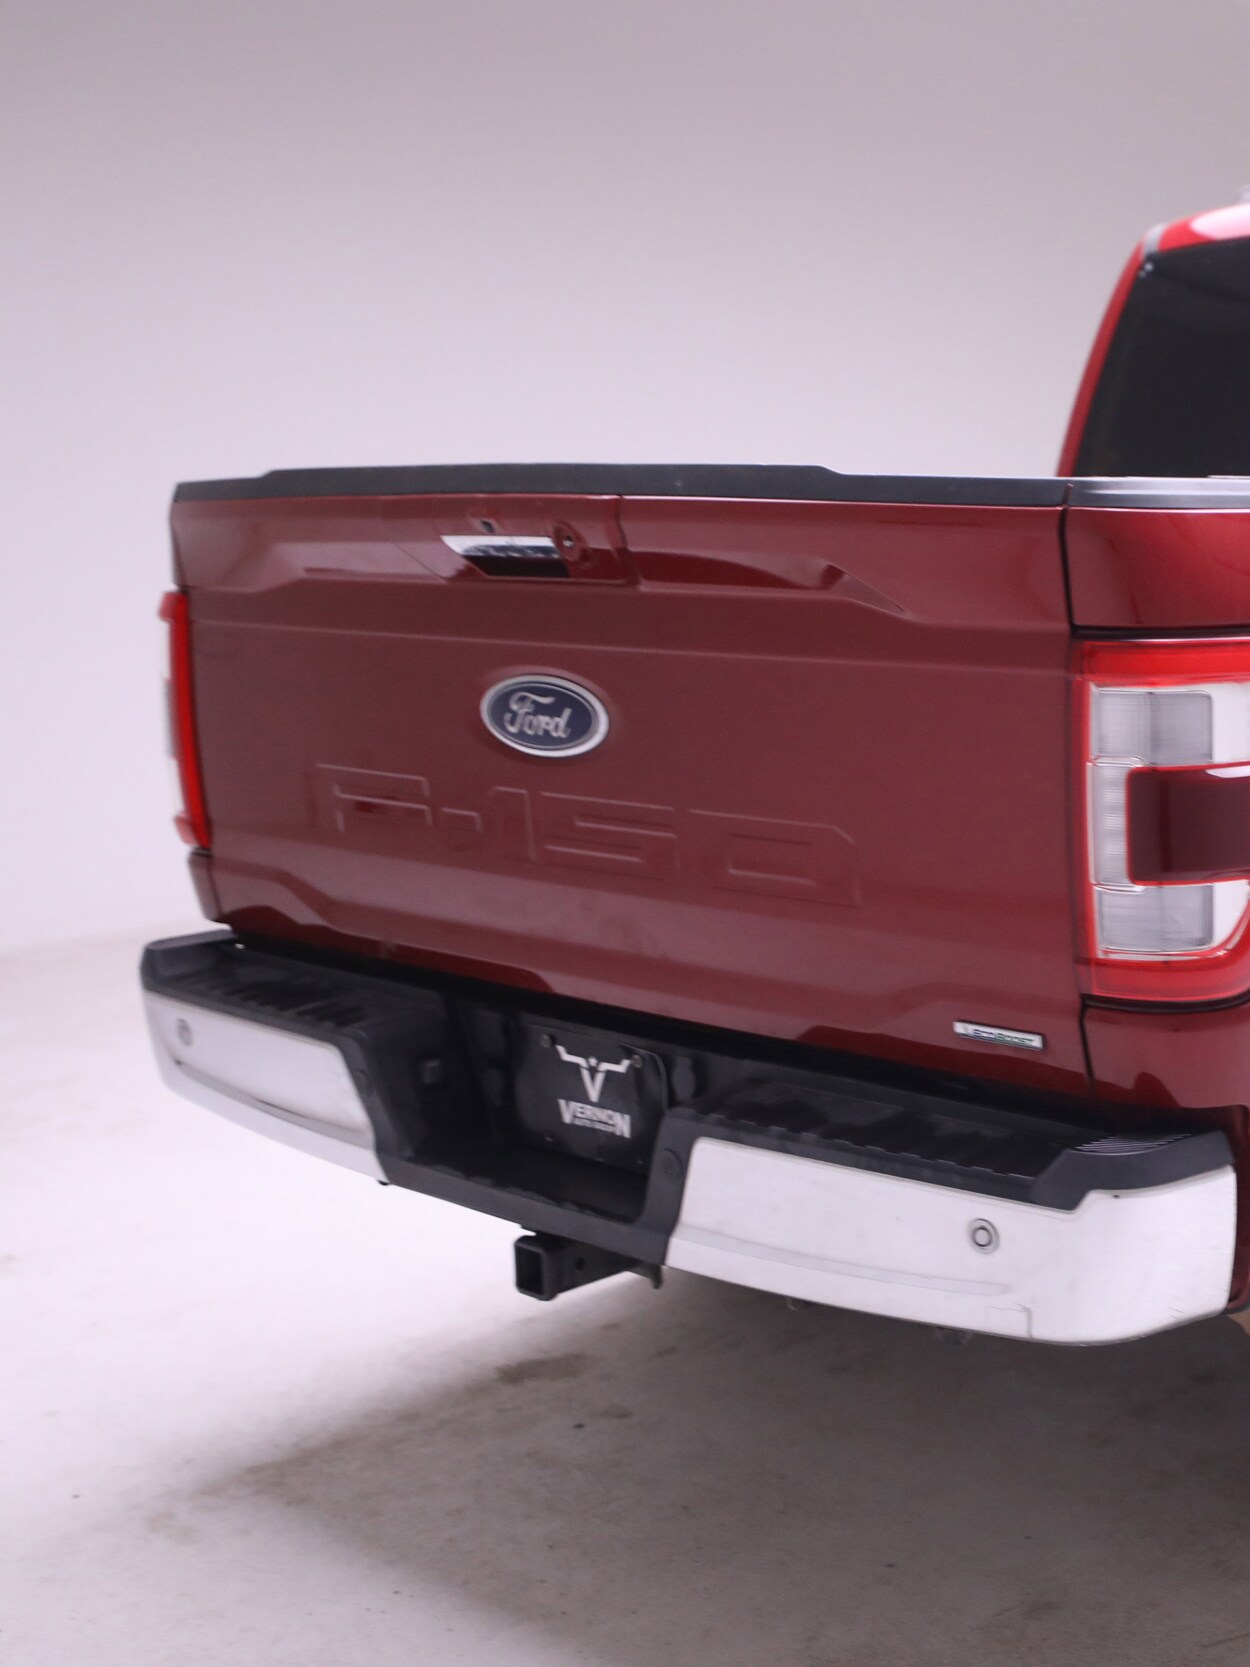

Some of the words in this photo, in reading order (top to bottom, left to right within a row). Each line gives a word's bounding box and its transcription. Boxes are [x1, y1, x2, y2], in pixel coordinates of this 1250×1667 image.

[503, 691, 573, 738] Ford
[311, 761, 862, 906] F-150
[558, 1099, 631, 1138] VERNON
